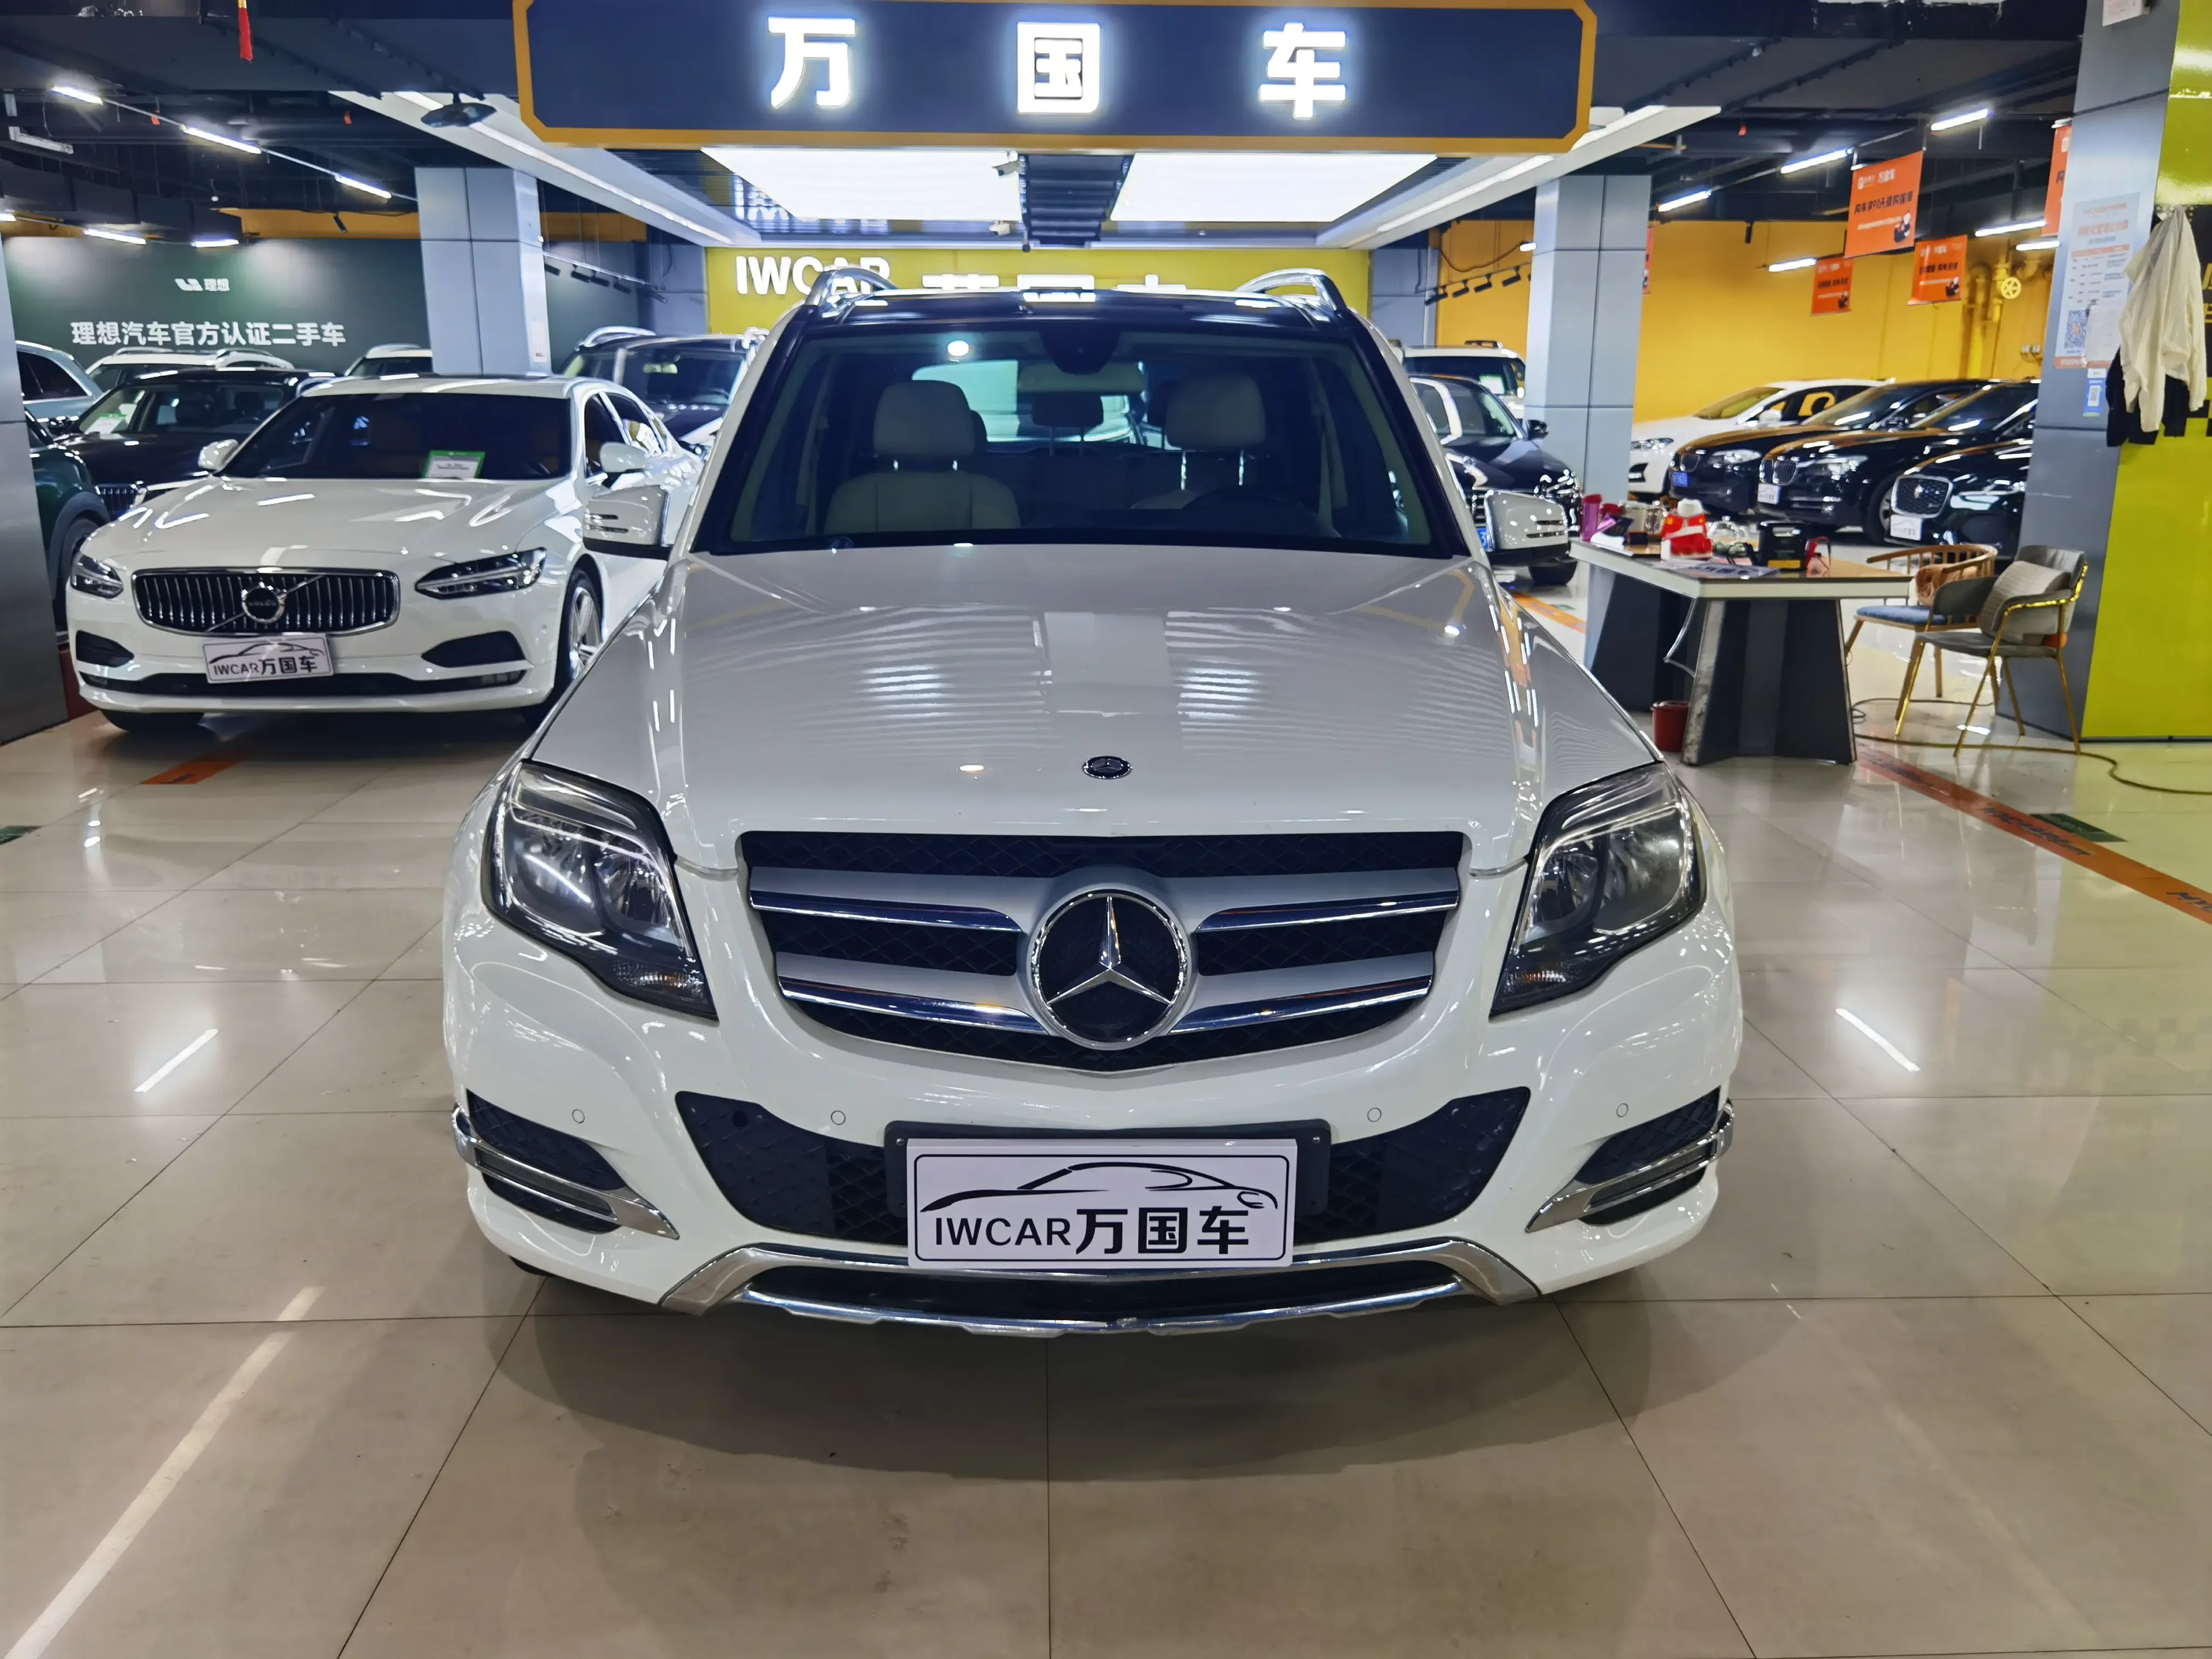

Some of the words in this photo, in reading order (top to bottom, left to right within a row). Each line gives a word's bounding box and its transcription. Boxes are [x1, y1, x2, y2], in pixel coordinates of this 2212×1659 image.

[768, 16, 1346, 119] 万国车
[70, 321, 346, 347] 理想汽车官方认证二手车
